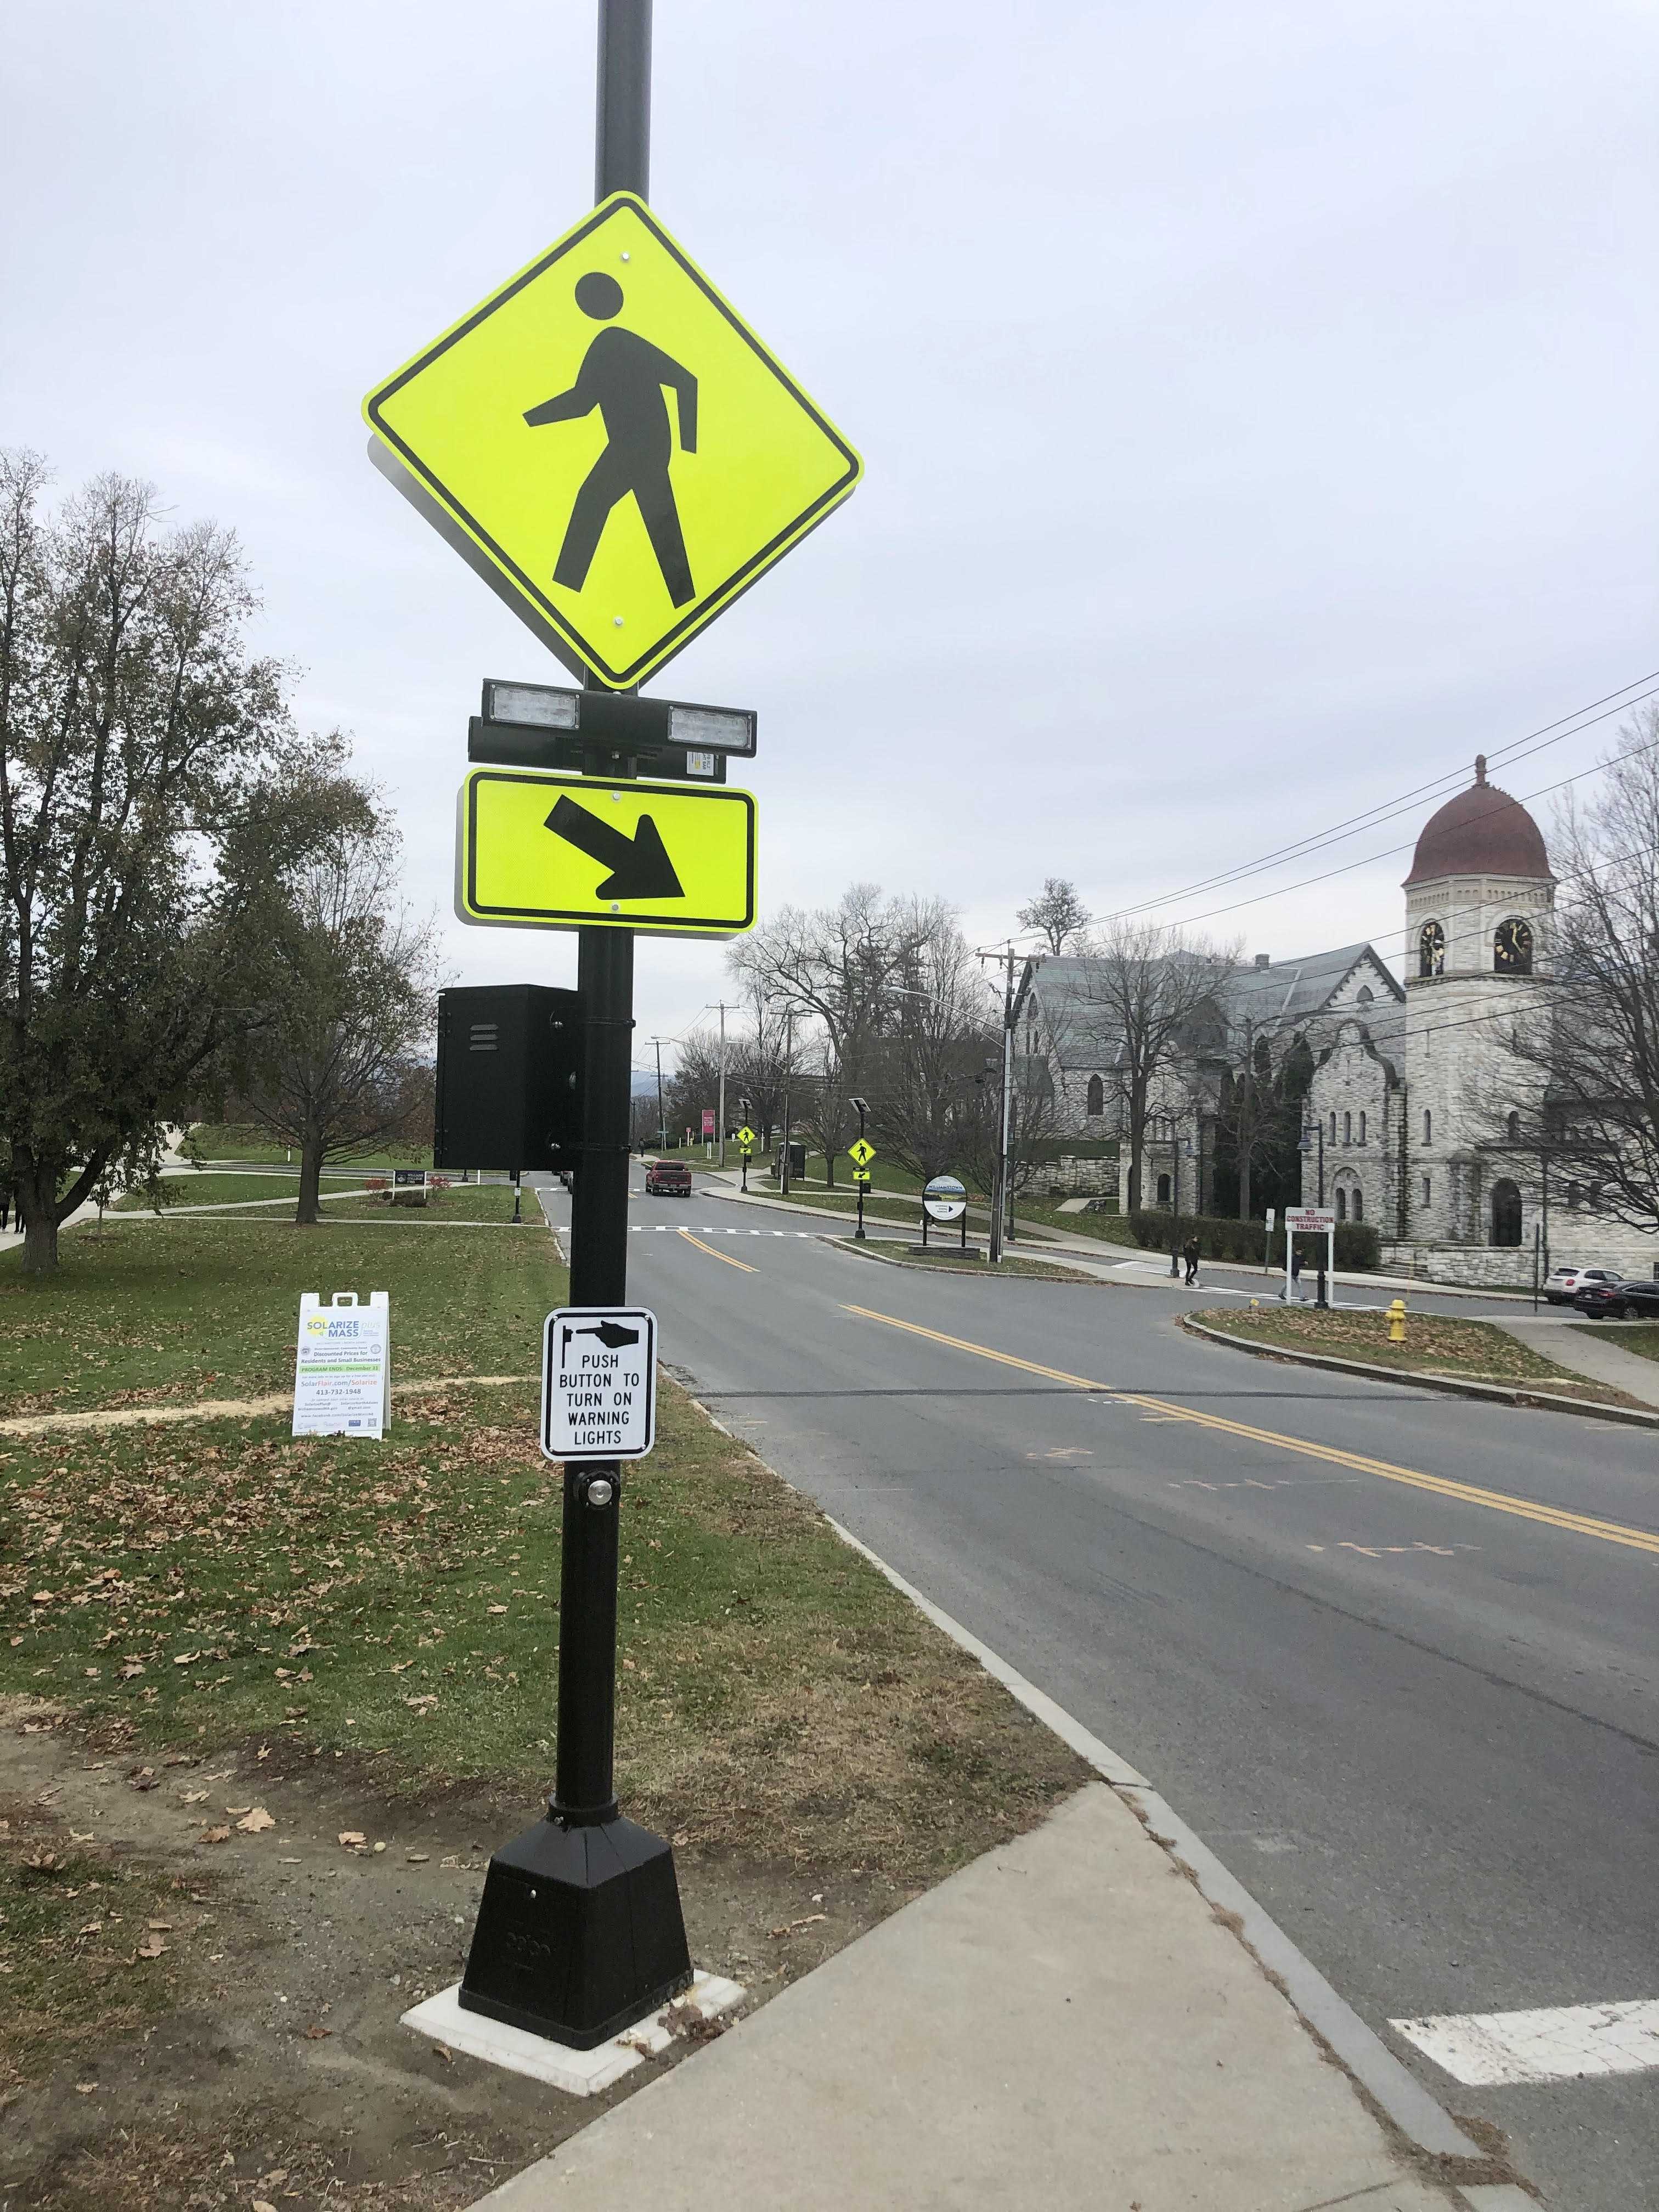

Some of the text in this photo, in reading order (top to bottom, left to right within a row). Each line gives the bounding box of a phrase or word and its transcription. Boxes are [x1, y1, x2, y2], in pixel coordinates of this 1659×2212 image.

[307, 1321, 359, 1330] SOLARIZE
[328, 1329, 359, 1338] MASS
[582, 1355, 619, 1368] PUSH
[301, 1379, 377, 1387] SolarFlair.com/Solarize
[560, 1373, 639, 1388] BUTTON TO
[567, 1392, 632, 1407] TURN ON
[568, 1411, 630, 1426] WARNING
[574, 1430, 622, 1445] LIGHTS
